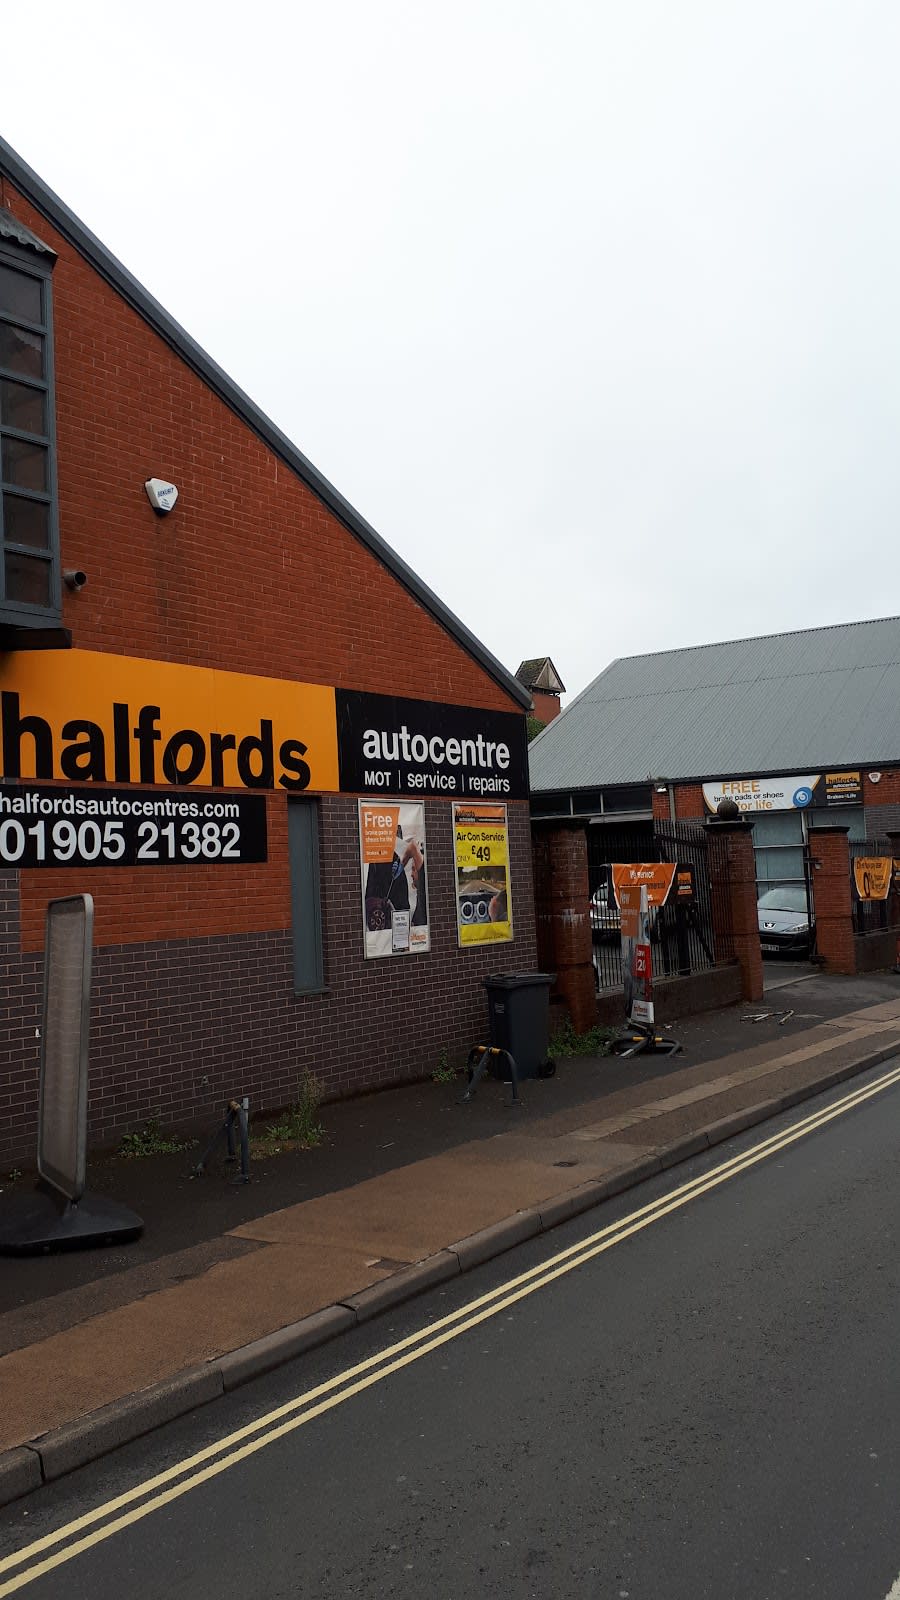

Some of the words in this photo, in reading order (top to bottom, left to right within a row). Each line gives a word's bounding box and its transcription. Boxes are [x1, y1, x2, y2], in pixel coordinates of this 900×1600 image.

[1, 691, 312, 790] halfords
[363, 725, 510, 769] autocentre
[365, 771, 391, 787] MOT
[407, 771, 456, 790] service
[469, 774, 510, 795] repairs
[722, 780, 761, 794] FREE
[0, 792, 240, 819] halfordsautocentres.com
[735, 793, 752, 801] pads
[364, 811, 393, 828] Free
[0, 819, 126, 862] 01905
[137, 821, 241, 859] 21382
[457, 832, 466, 841] Air
[467, 832, 480, 841] Con
[481, 832, 505, 841] Service
[471, 845, 491, 861] £49
